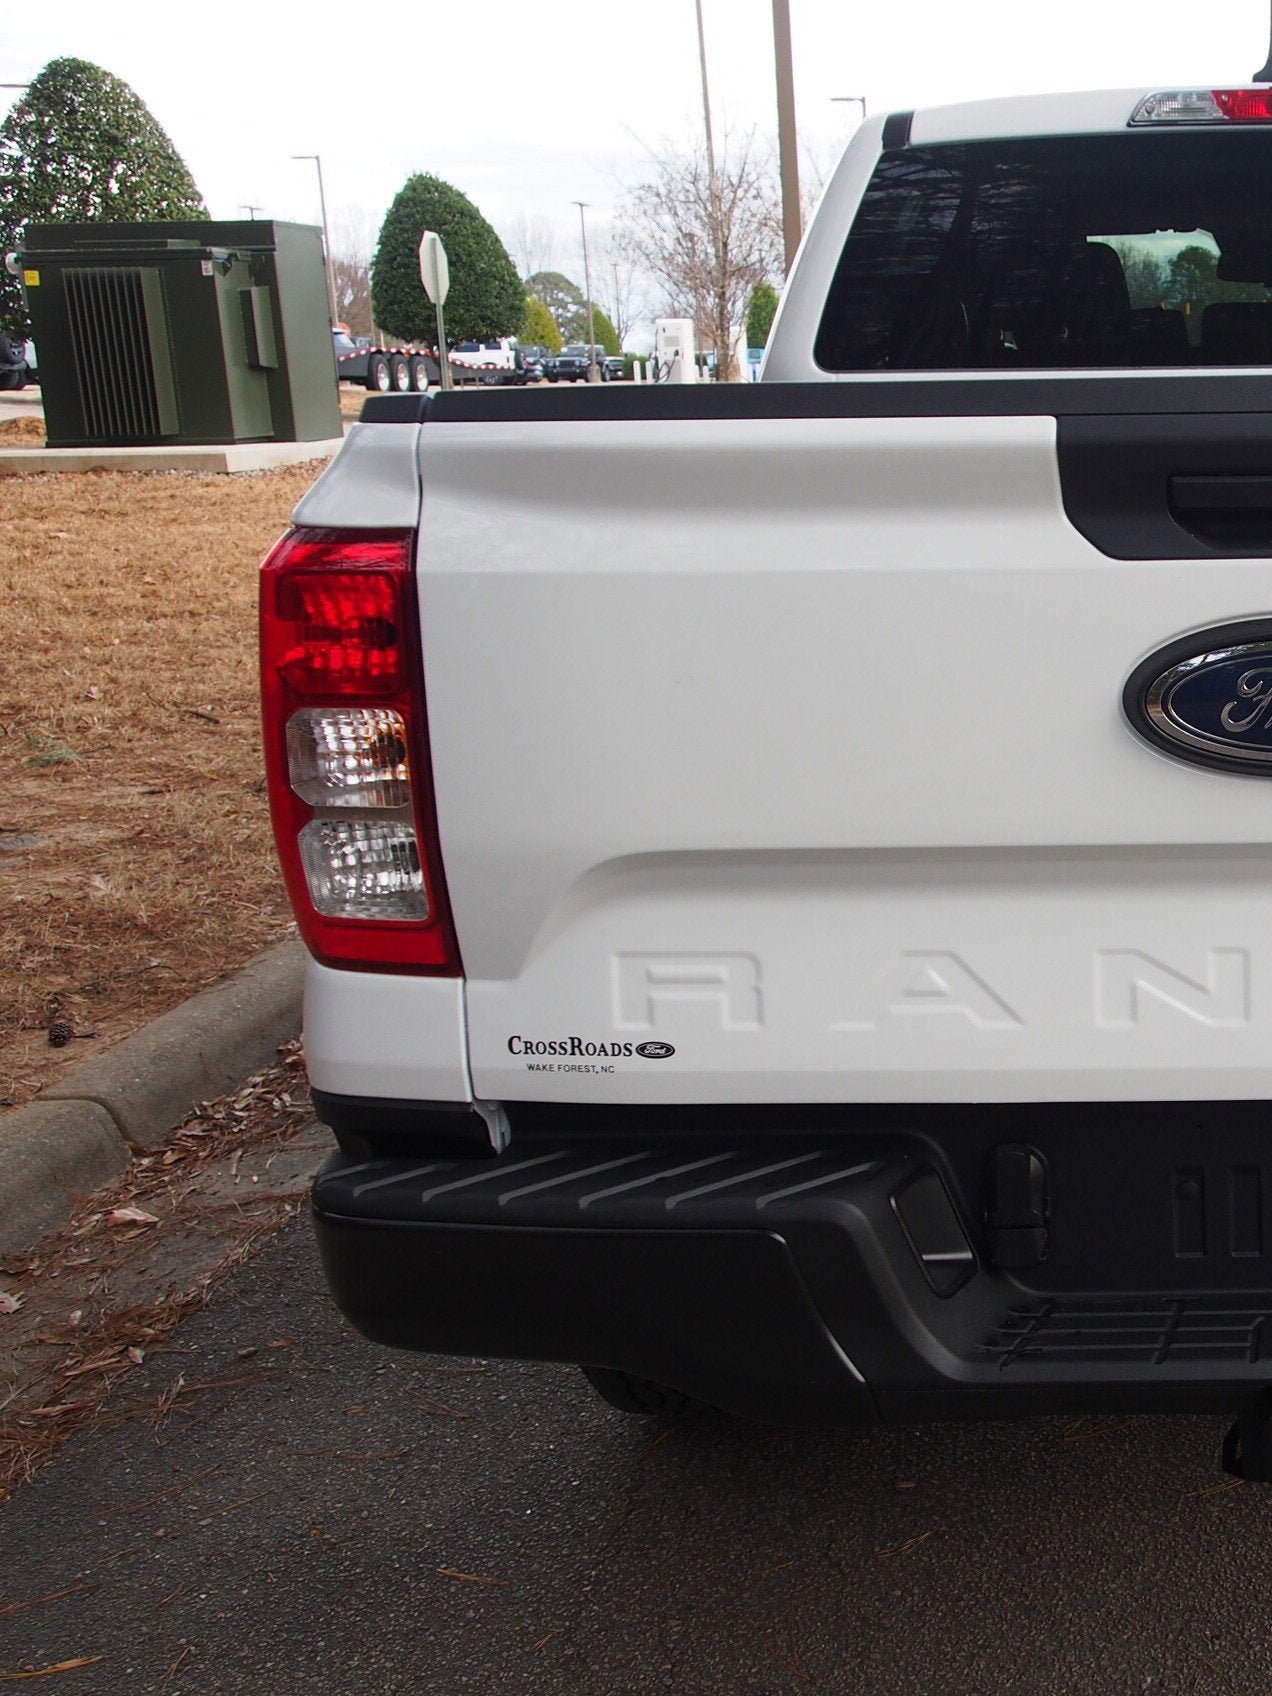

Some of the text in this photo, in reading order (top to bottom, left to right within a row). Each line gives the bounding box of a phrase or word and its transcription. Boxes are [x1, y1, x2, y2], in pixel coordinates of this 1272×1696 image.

[526, 1063, 615, 1074] WAKE FOREST, NC
